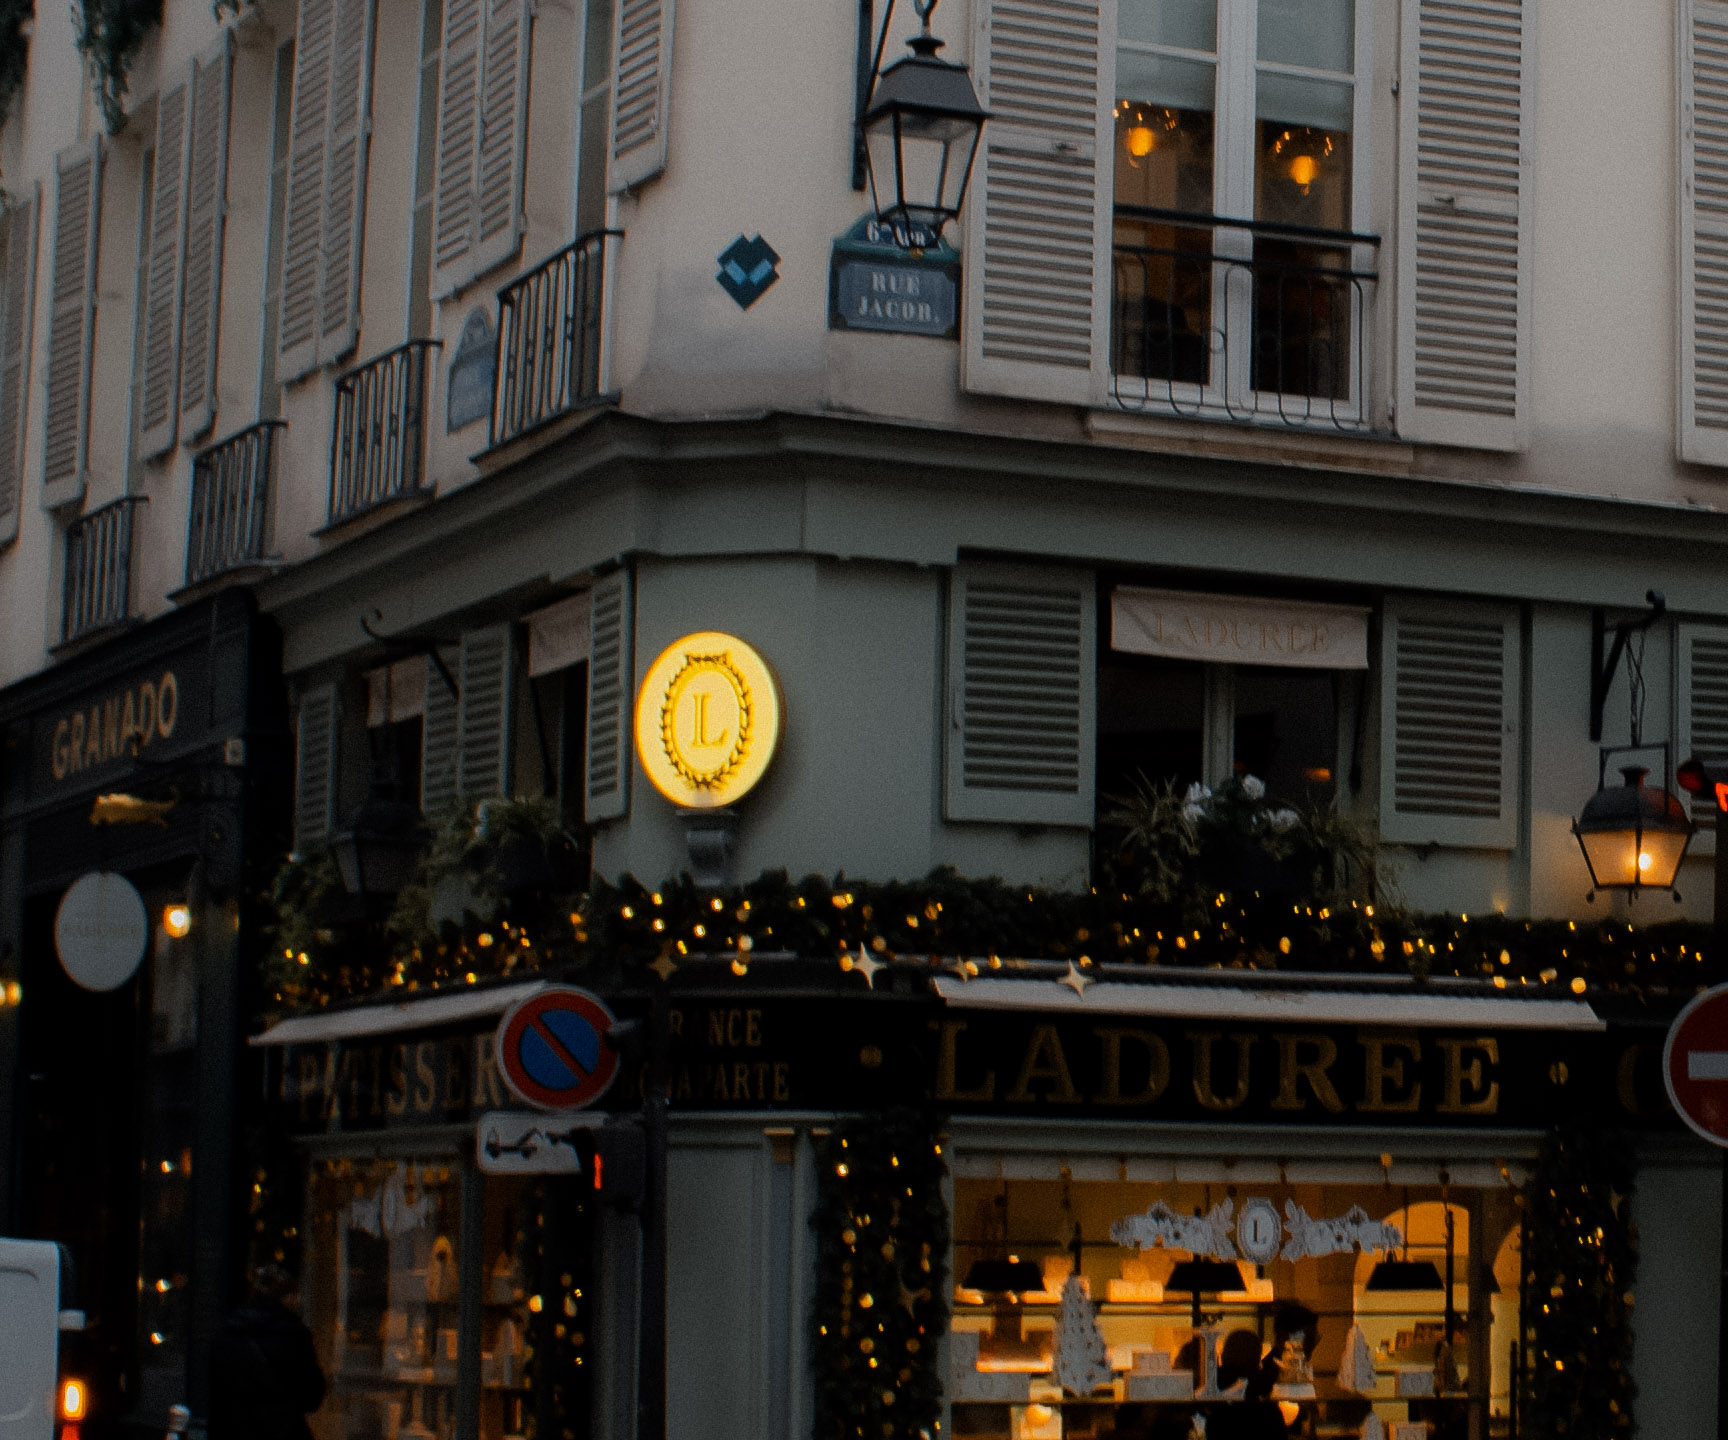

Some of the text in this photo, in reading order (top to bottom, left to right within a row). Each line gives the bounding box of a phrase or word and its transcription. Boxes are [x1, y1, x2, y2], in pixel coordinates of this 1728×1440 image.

[870, 271, 920, 295] RUE
[51, 670, 177, 780] GRANADO
[691, 692, 729, 748] L
